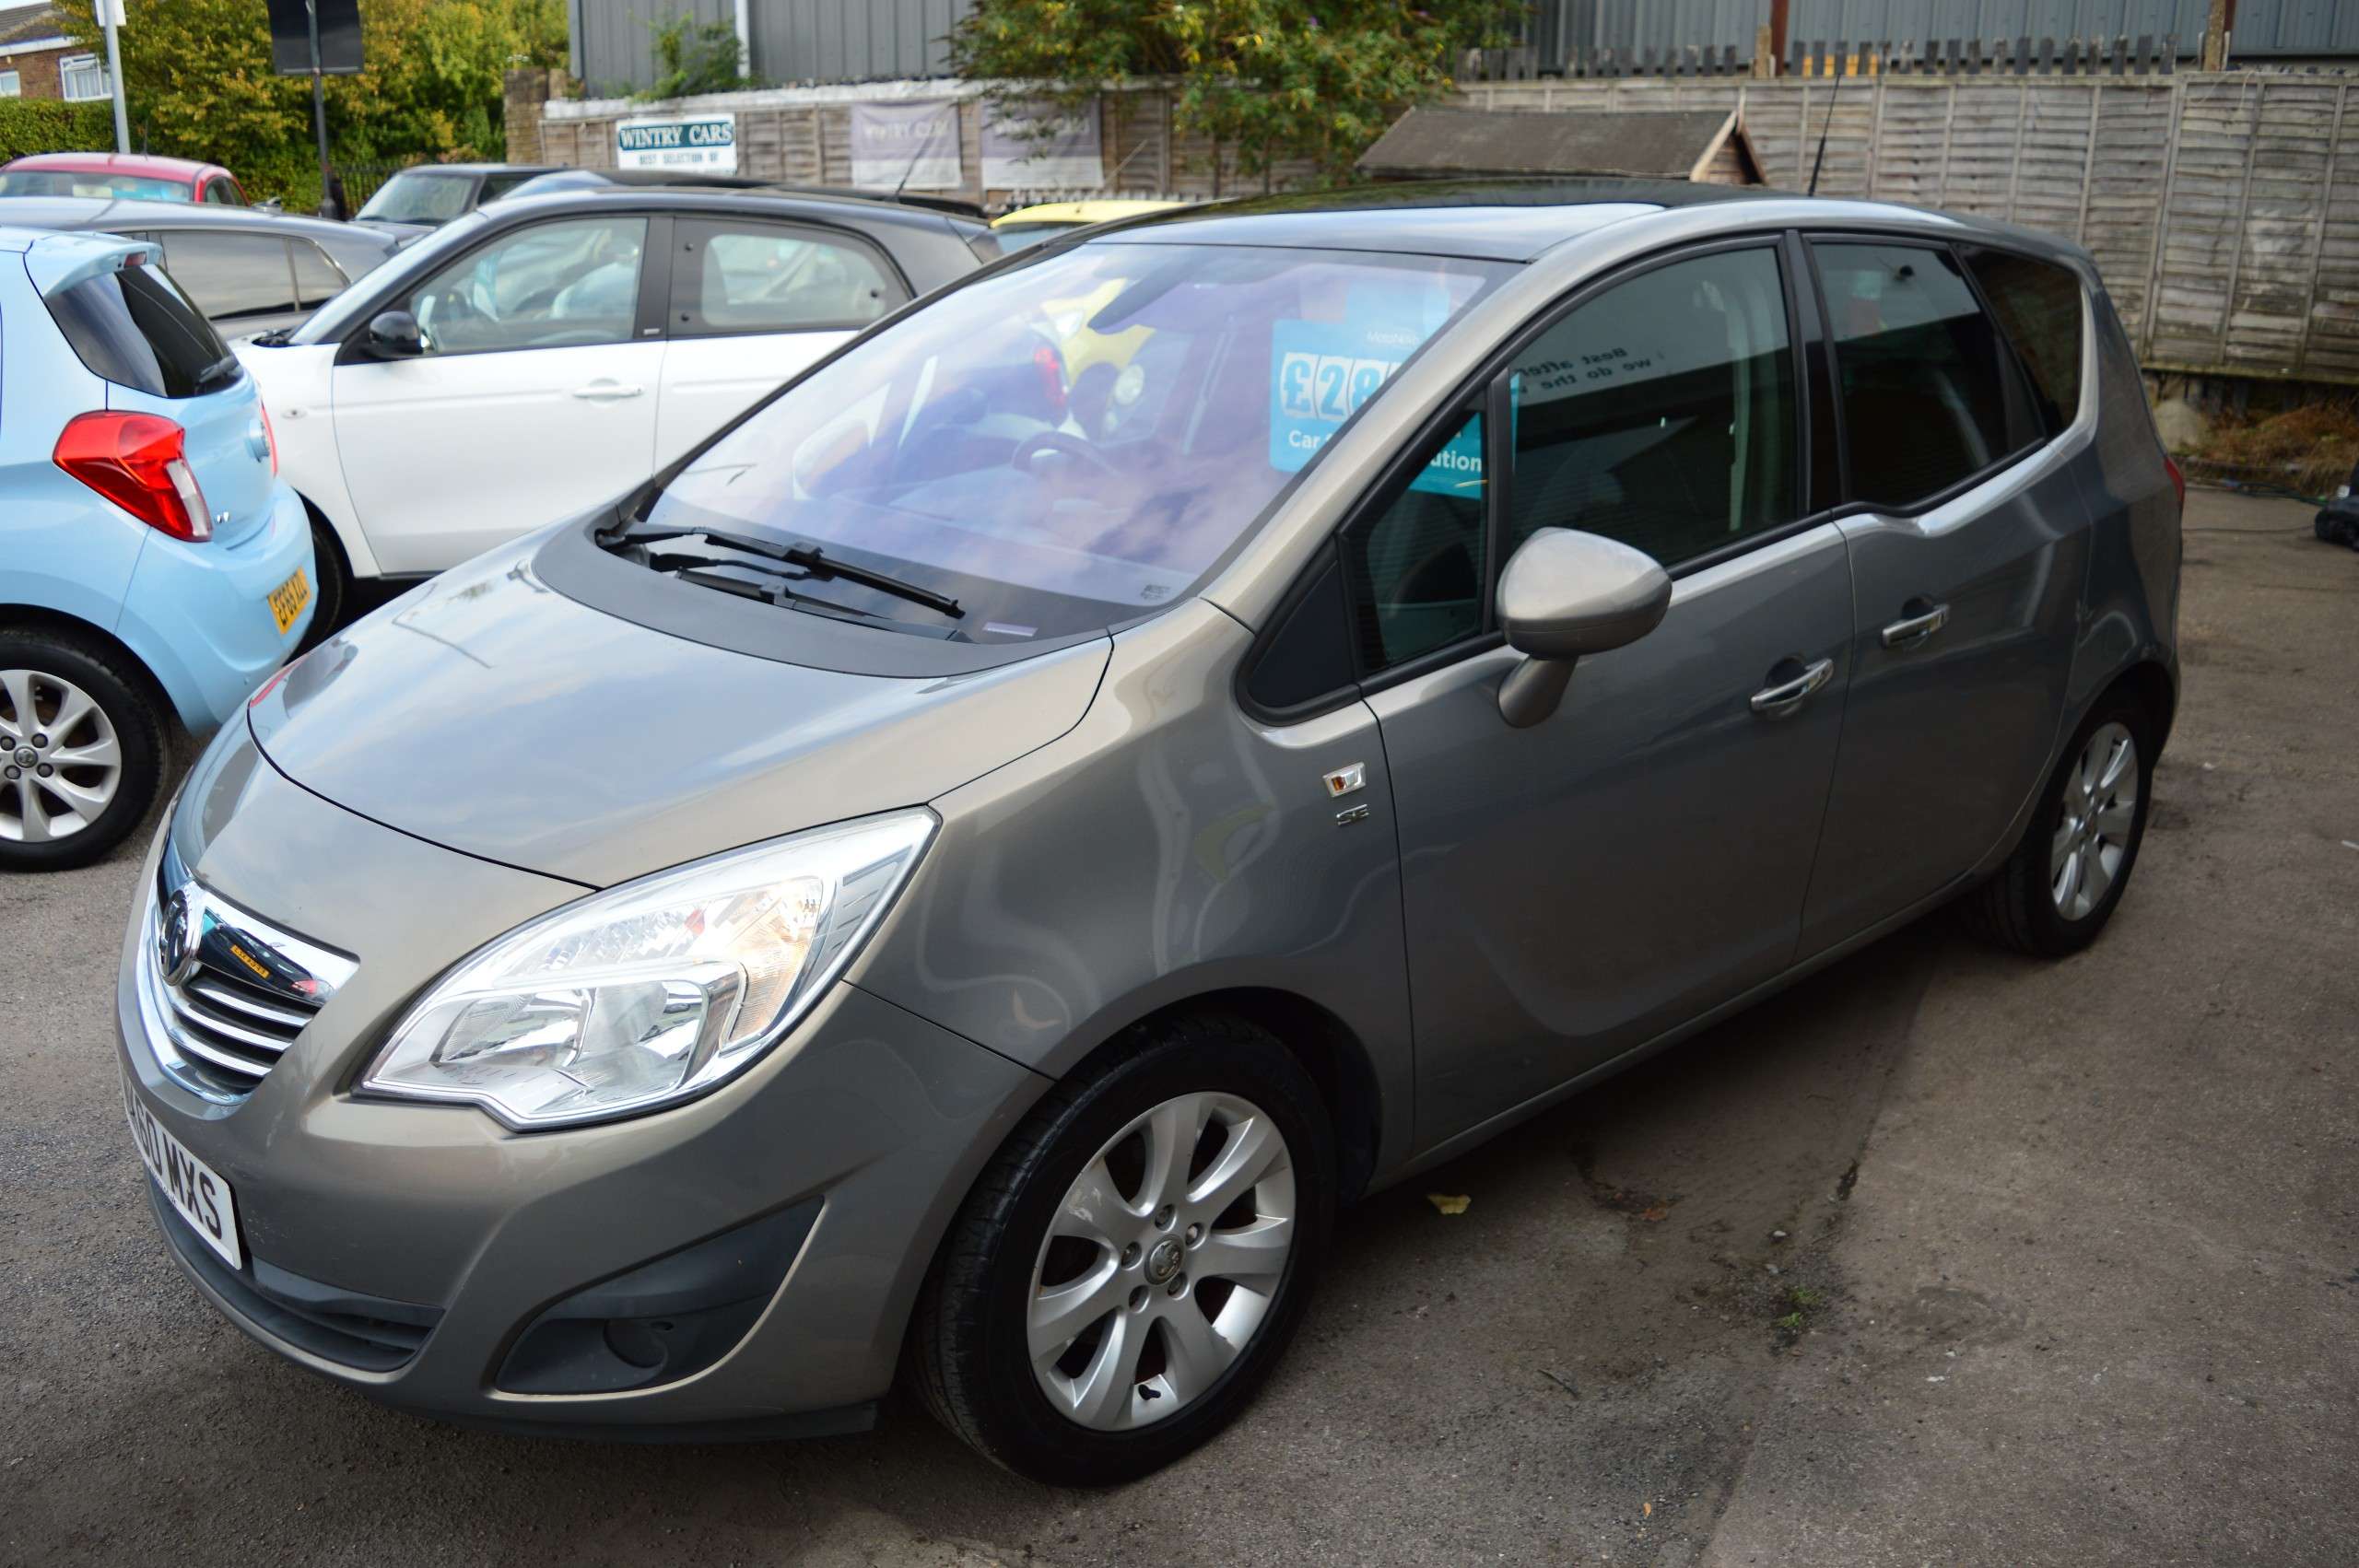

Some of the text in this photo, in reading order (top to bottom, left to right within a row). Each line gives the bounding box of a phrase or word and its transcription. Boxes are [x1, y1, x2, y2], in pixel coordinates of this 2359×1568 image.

[619, 123, 734, 148] WINTRY CARS
[1288, 429, 1320, 449] Car
